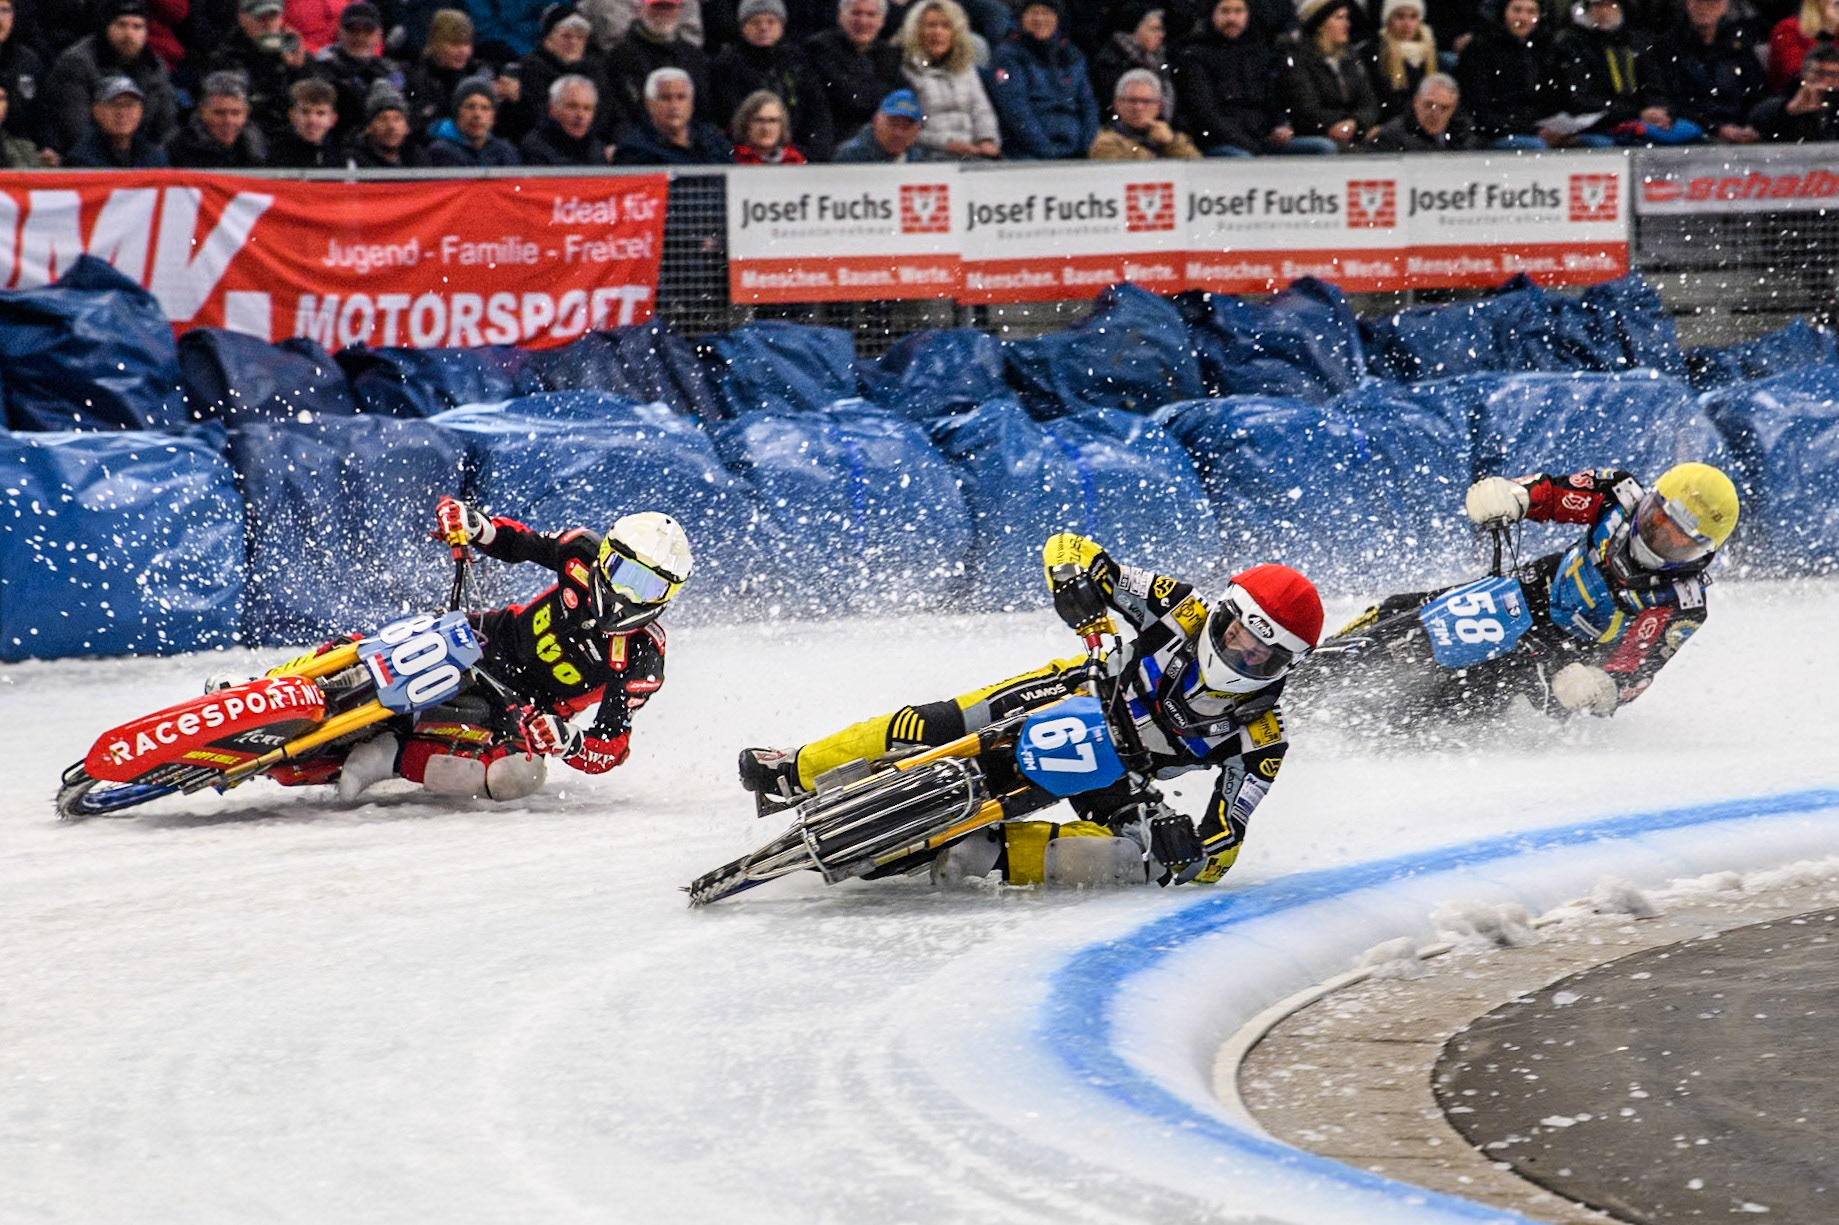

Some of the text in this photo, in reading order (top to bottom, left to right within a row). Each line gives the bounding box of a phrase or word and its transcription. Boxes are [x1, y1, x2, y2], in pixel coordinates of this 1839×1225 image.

[553, 192, 657, 224] Ideal für
[741, 192, 892, 229] Josef Fuchs
[967, 193, 1118, 231] Josef Fuchs
[1187, 187, 1339, 221] Josef Fuchs
[1408, 181, 1561, 216] Josef Fuchs
[324, 237, 420, 275] Jugend
[441, 234, 541, 266] Familie
[1430, 616, 1453, 646] FIM
[1447, 591, 1505, 644] 58
[380, 615, 461, 704] 800
[532, 603, 582, 686] 800
[1020, 683, 1067, 701] VUMOS
[1020, 750, 1037, 771] FIM
[1029, 716, 1098, 774] 67
